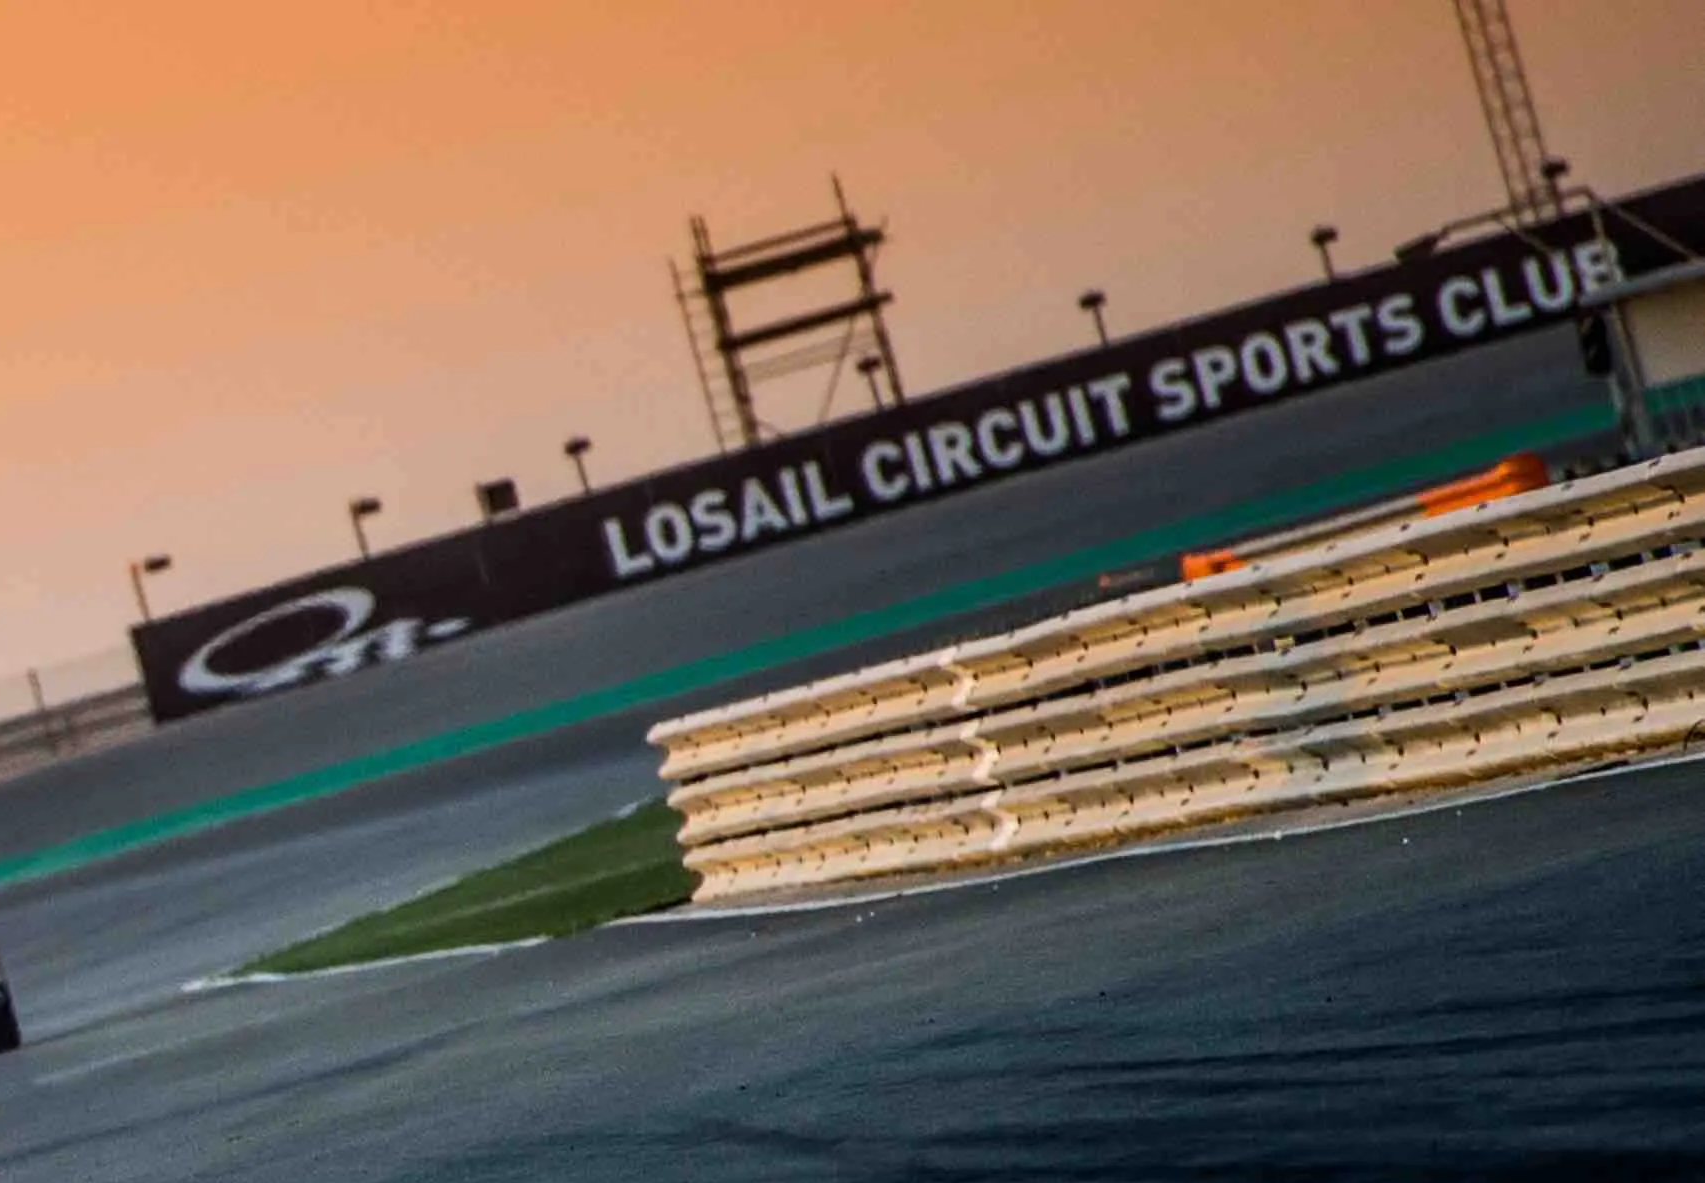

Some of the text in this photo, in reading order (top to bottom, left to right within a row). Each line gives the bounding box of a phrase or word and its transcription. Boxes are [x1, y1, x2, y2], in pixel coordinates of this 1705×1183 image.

[602, 241, 1624, 579] LOSAIL CIRCUIT SPORTS CLUB
